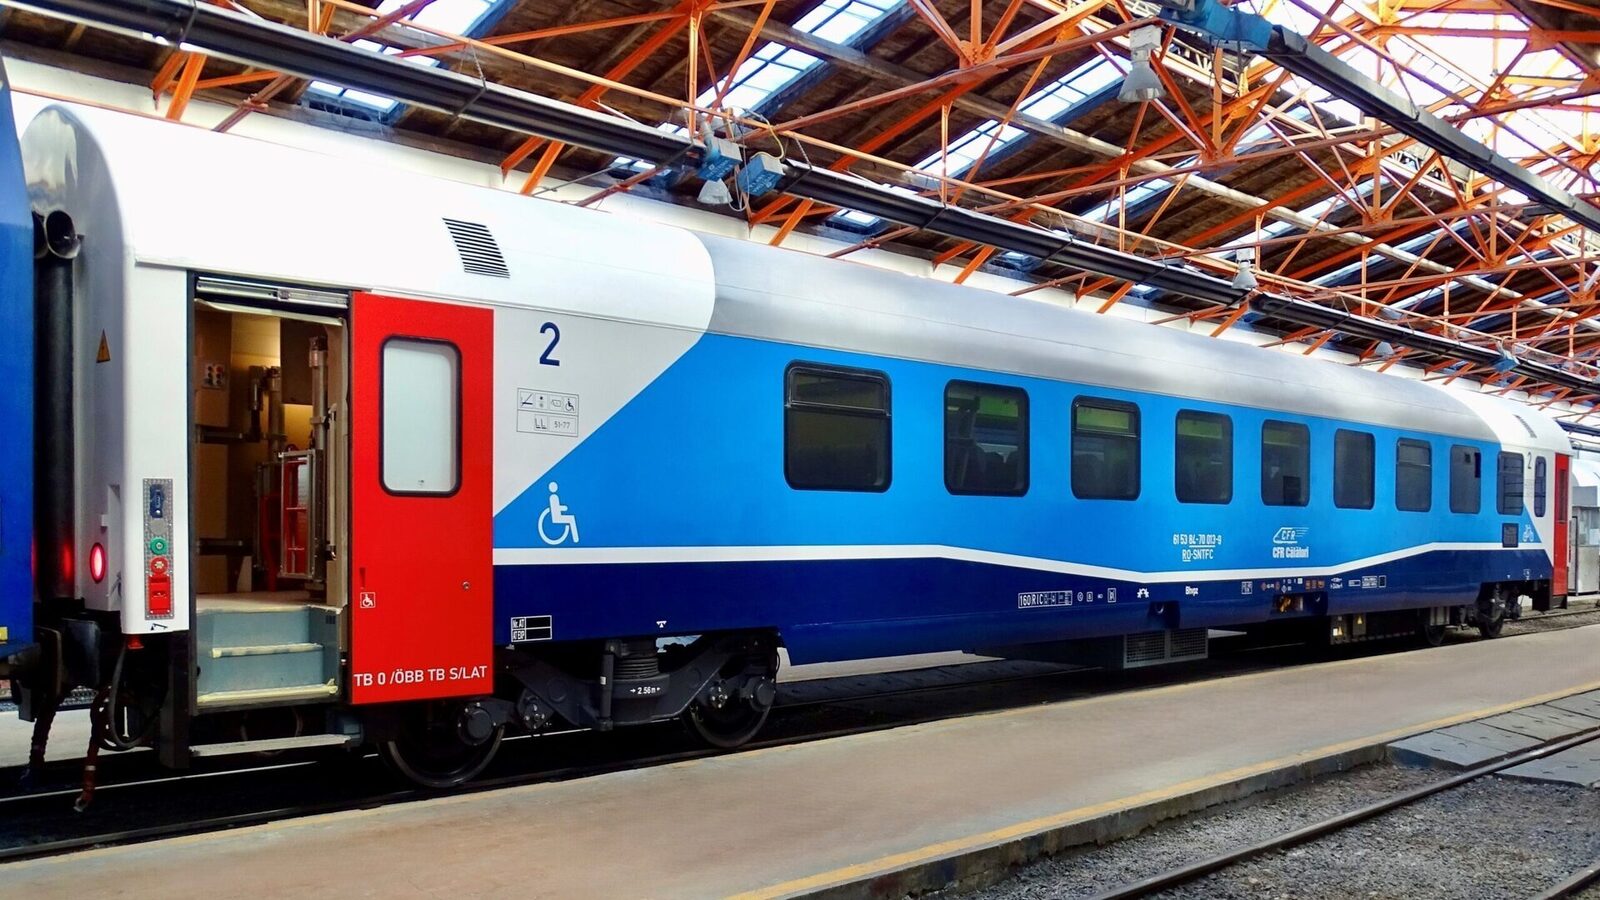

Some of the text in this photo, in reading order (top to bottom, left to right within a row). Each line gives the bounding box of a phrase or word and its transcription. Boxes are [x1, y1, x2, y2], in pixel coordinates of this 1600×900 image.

[539, 321, 561, 367] 2
[1281, 530, 1296, 541] CFR
[1272, 546, 1285, 559] CFR
[353, 673, 374, 687] TB
[427, 668, 446, 681] TB
[449, 665, 488, 680] S/LAT
